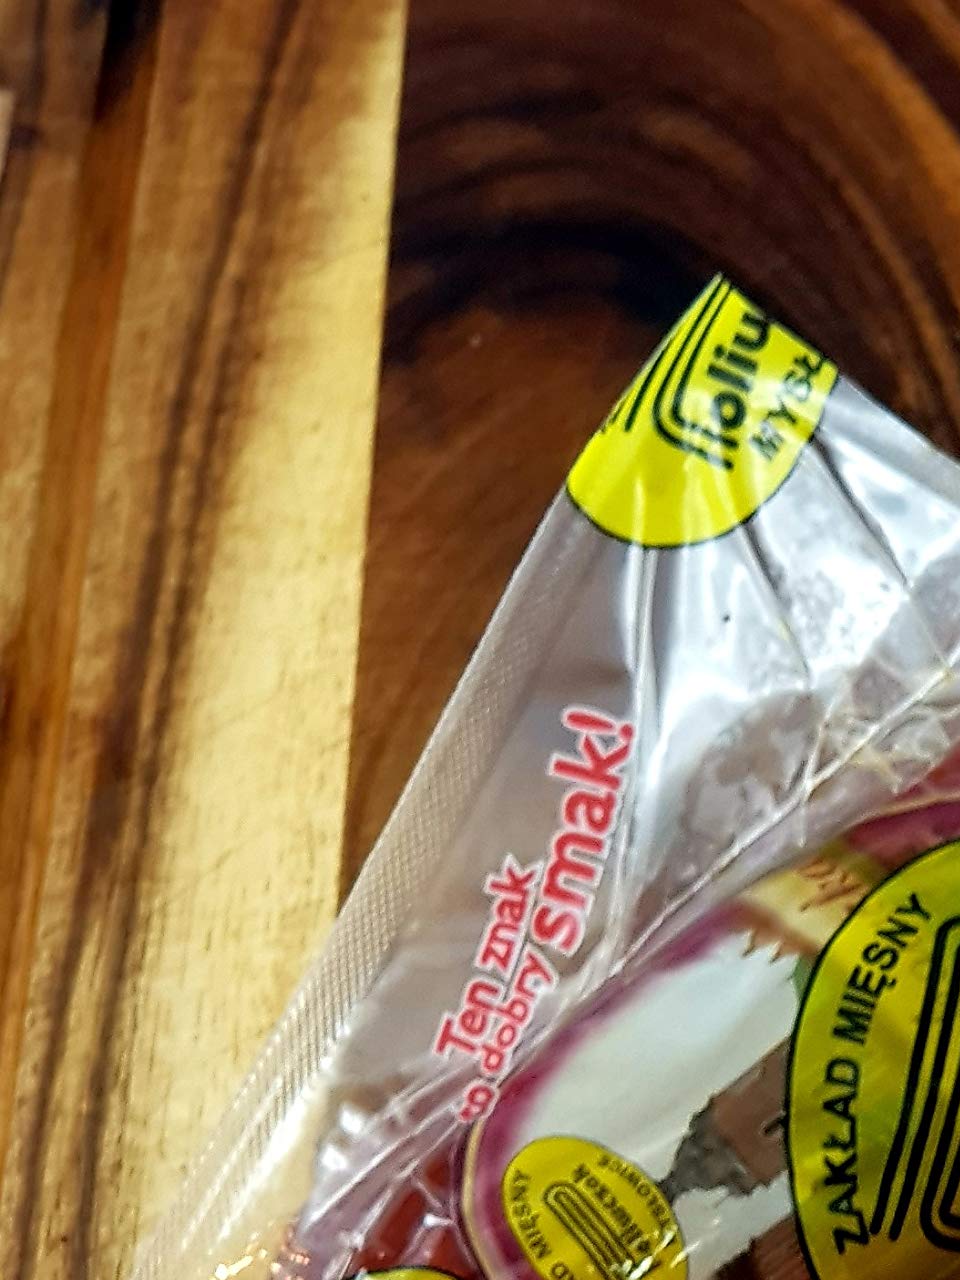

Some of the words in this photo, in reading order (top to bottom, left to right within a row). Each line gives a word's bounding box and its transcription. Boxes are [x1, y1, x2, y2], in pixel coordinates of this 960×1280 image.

[434, 978, 501, 1056] Ten
[479, 856, 540, 971] znak
[480, 944, 555, 1075] dobry
[532, 708, 636, 955] smak!
[832, 893, 933, 1045] MIĘSNY
[823, 1058, 869, 1255] ZAKŁAD
